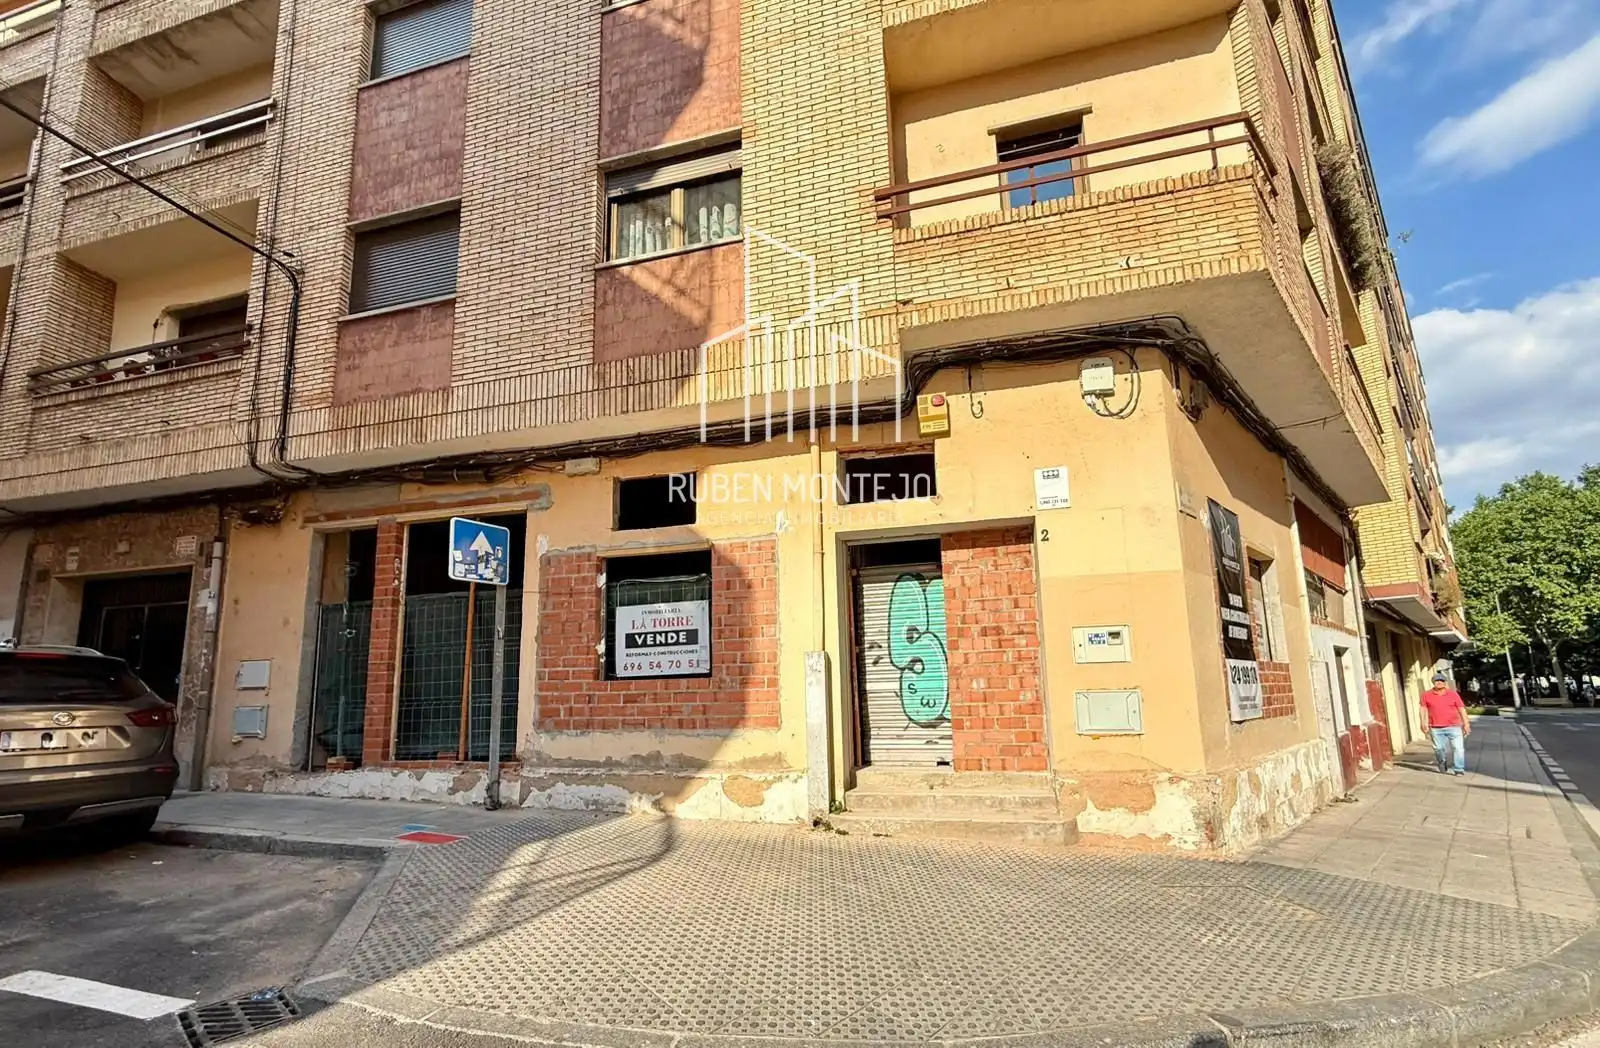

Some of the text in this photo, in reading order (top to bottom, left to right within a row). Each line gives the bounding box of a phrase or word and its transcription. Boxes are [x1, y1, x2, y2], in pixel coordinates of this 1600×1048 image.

[1041, 529, 1050, 542] 2
[632, 615, 694, 630] LA TORRE
[635, 631, 688, 645] VENDE
[623, 662, 642, 671] 696
[648, 661, 662, 670] 54
[668, 660, 681, 669] 70
